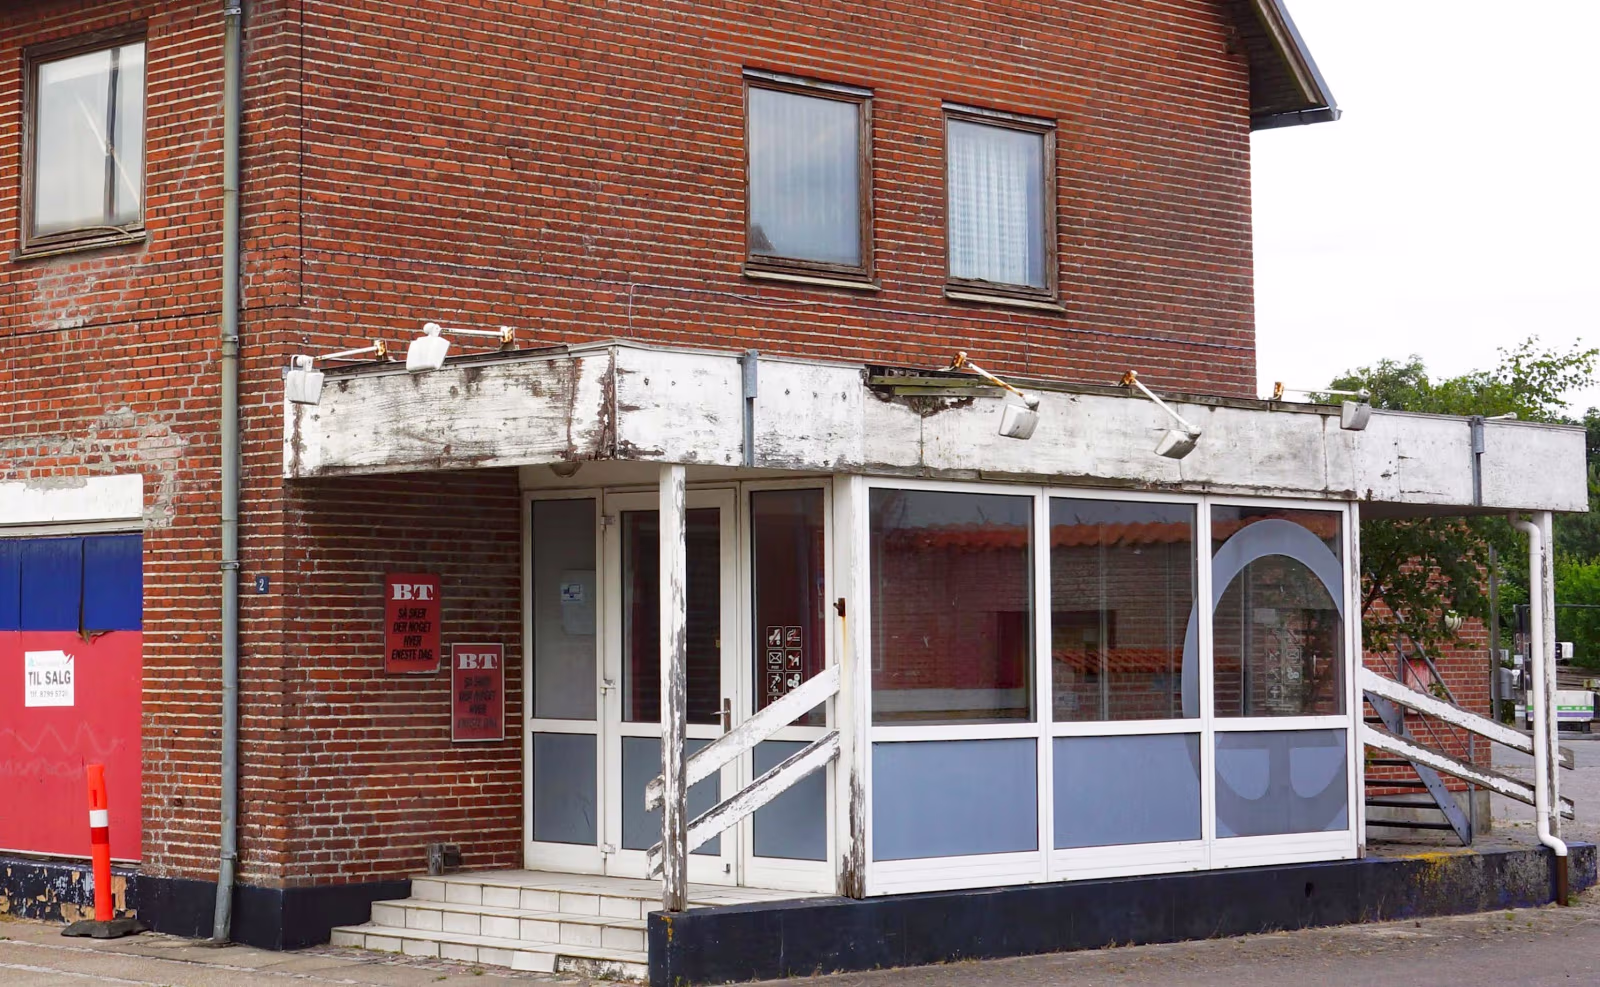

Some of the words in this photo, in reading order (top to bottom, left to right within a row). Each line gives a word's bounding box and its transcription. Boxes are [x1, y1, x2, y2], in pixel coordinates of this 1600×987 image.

[259, 578, 265, 591] 2
[391, 584, 433, 600] B.T.
[393, 622, 408, 632] DER
[408, 622, 432, 632] NOGET
[403, 635, 422, 647] HVER
[392, 649, 418, 660] ENESTE
[457, 653, 498, 669] B.T.
[28, 671, 42, 686] TIL
[45, 670, 71, 685] SALG
